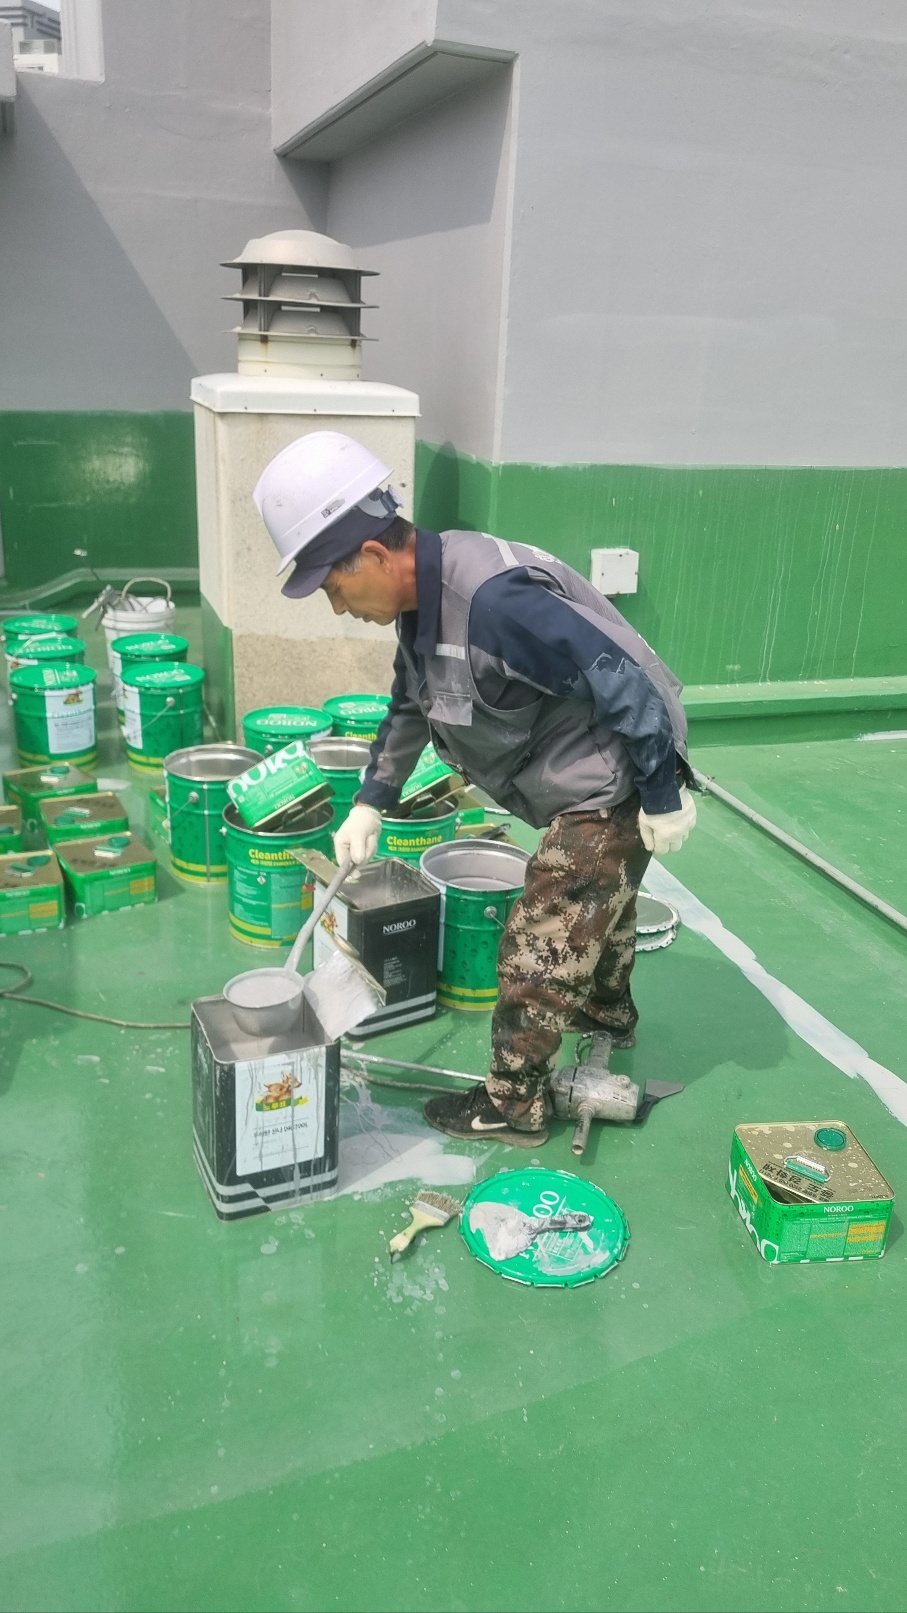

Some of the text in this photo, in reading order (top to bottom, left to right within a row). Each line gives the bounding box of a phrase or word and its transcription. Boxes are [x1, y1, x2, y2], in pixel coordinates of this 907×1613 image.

[386, 835, 443, 846] Cleanthane
[382, 919, 417, 934] NOROO
[823, 1205, 855, 1214] NOROO
